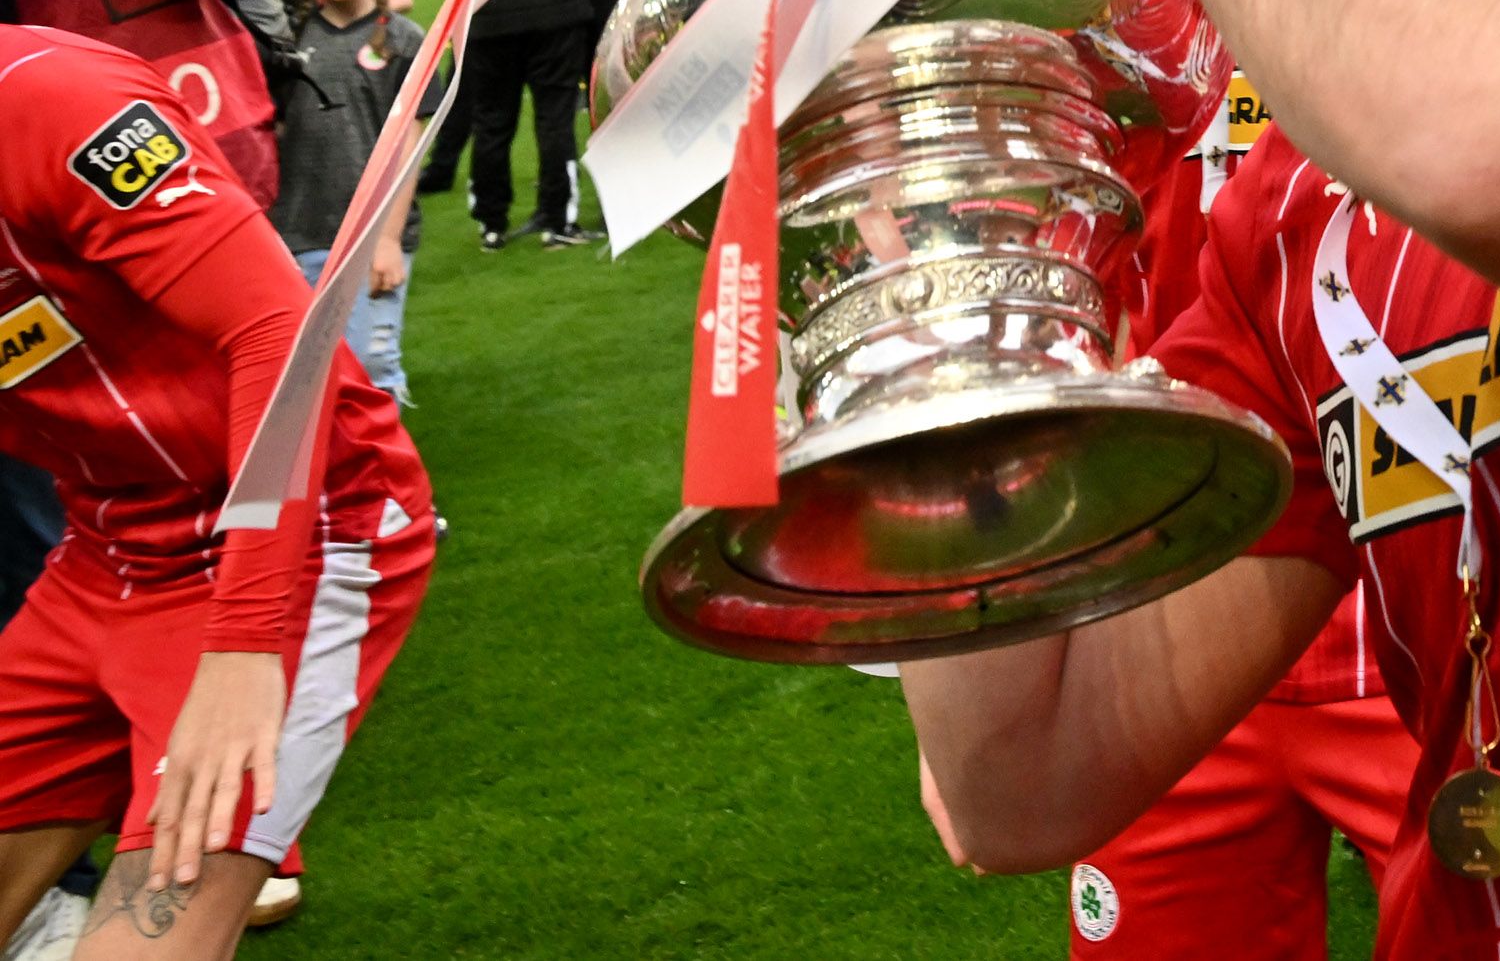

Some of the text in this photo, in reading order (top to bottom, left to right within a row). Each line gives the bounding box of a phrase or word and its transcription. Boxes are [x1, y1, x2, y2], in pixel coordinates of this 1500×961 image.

[86, 117, 157, 172] fona
[111, 134, 180, 193] CAB
[0, 321, 47, 369] AM
[716, 254, 736, 388] CLEARER
[738, 261, 763, 376] WATER
